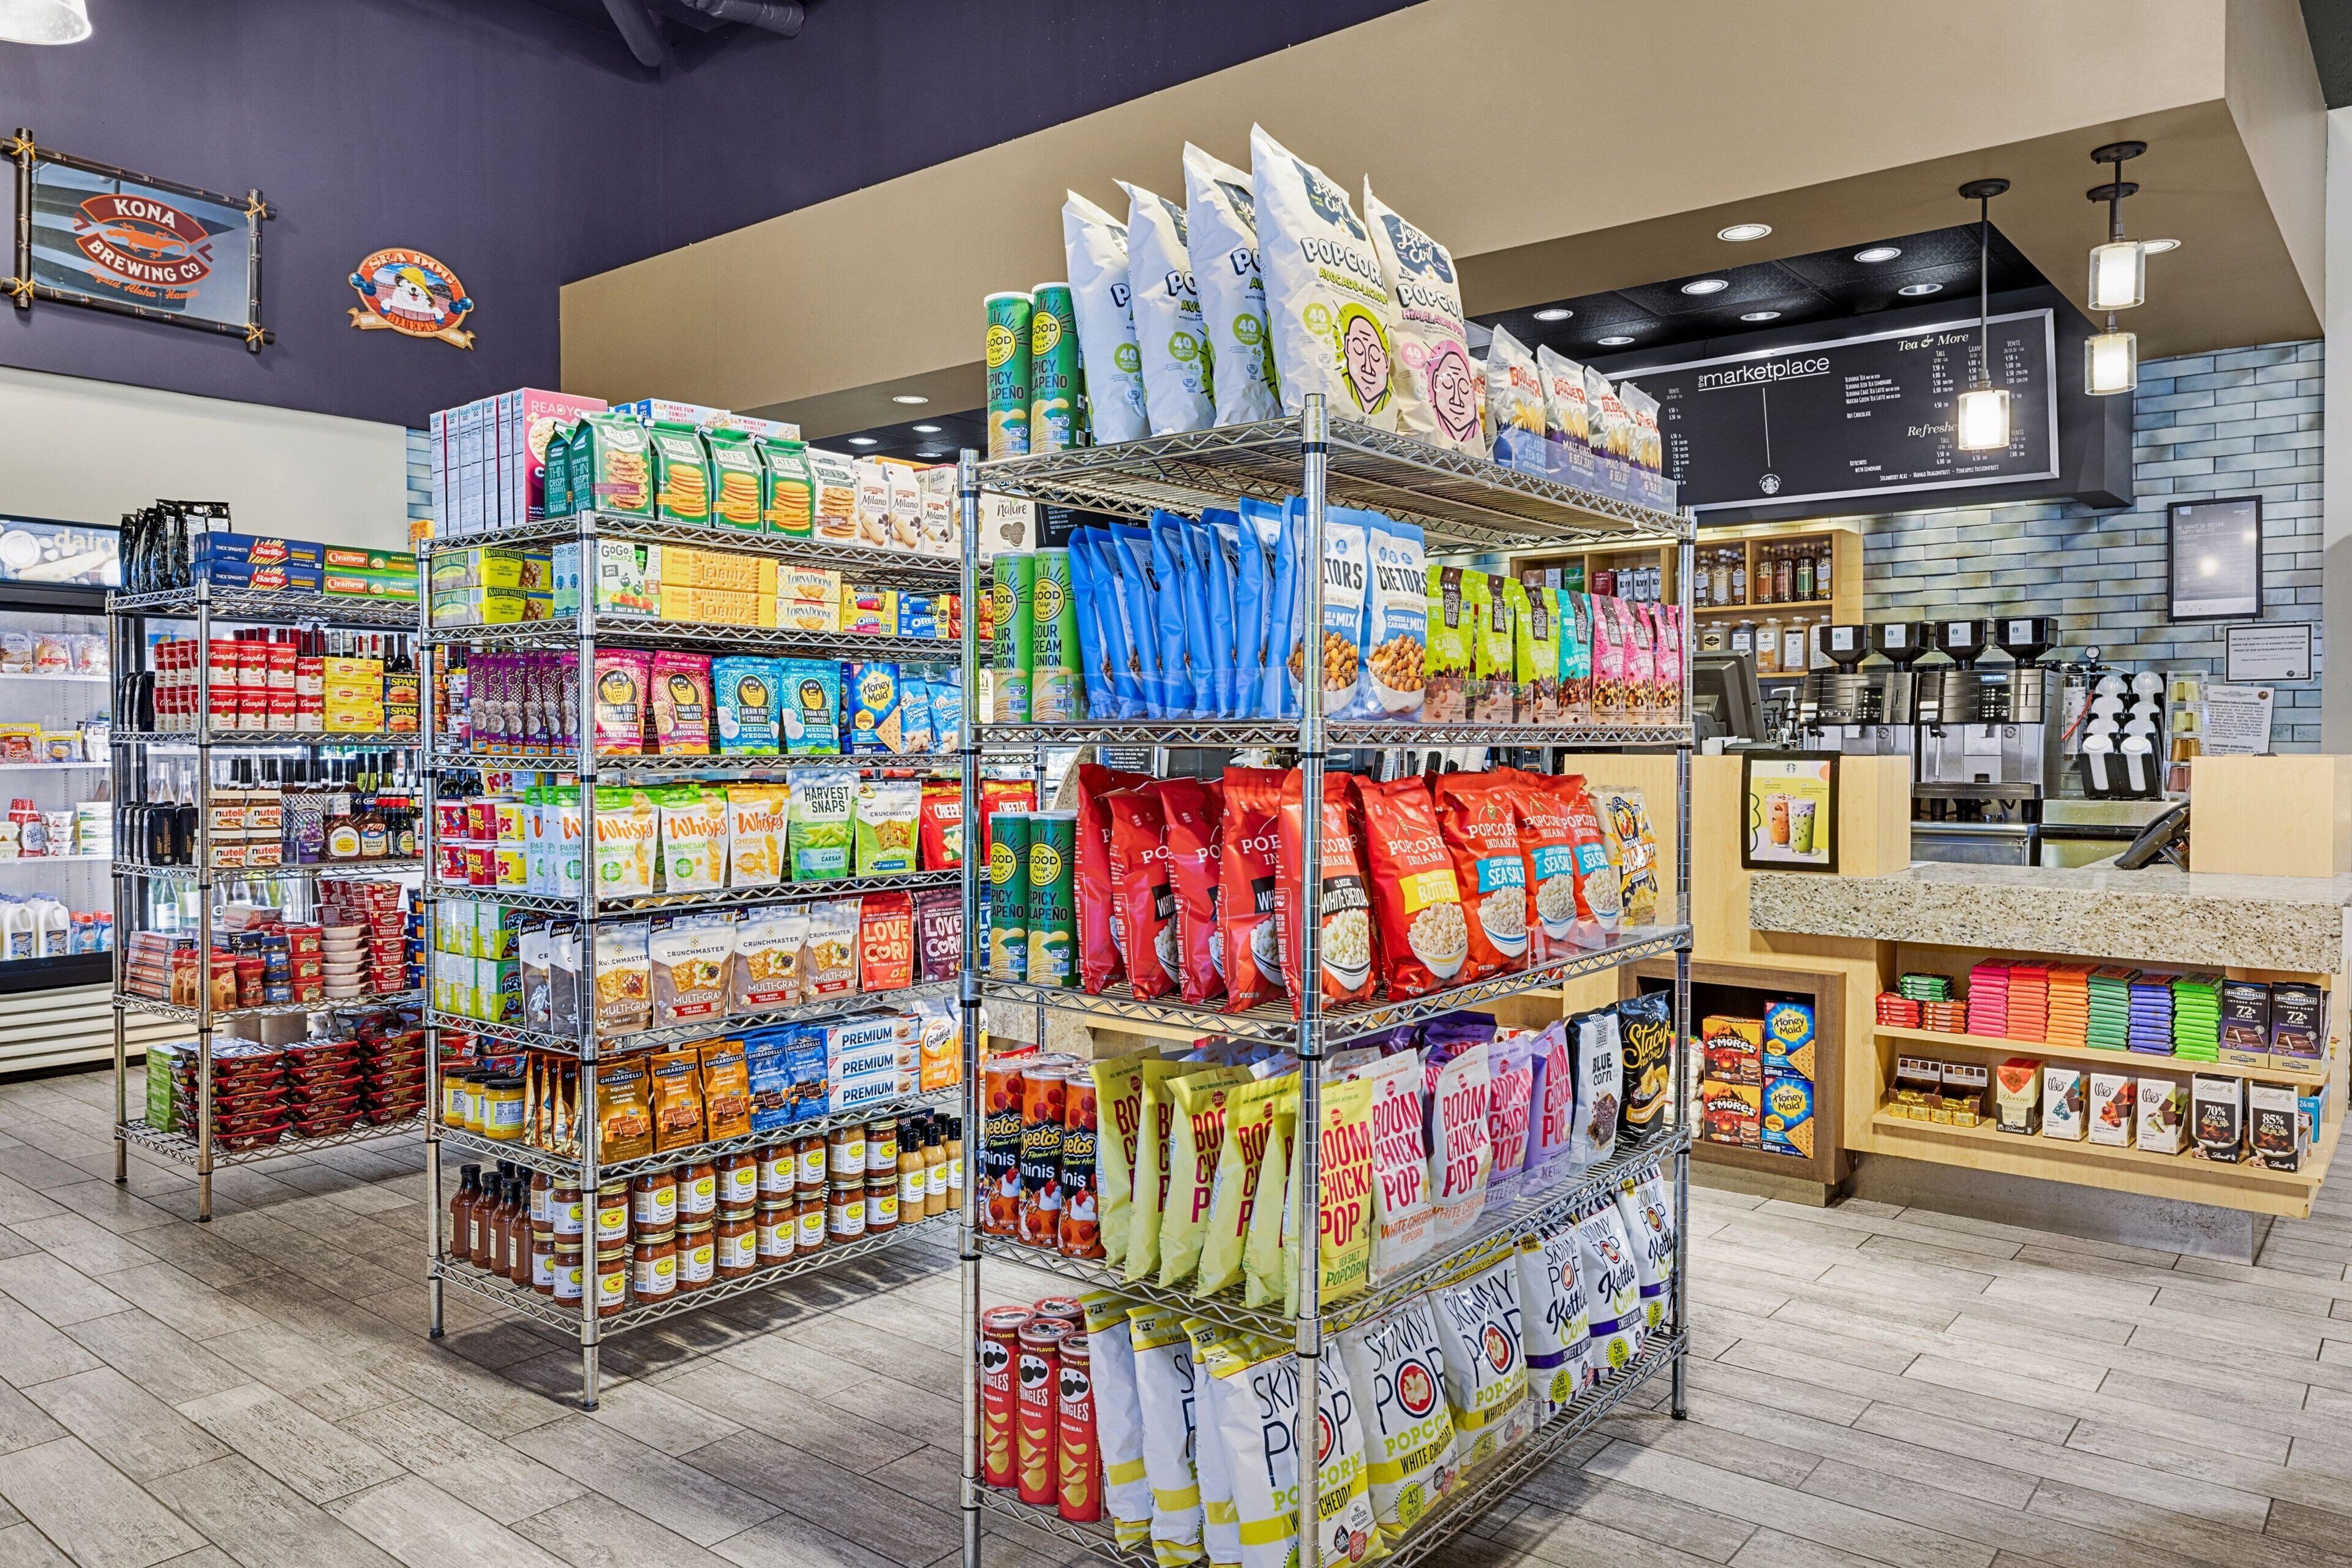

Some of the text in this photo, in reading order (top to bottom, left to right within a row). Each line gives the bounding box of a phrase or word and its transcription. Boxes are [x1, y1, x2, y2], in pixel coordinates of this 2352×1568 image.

[113, 199, 175, 228] KONA
[88, 239, 176, 281] BREWING
[369, 252, 455, 284] SEA DOG
[124, 284, 156, 297] Aloha
[1898, 333, 1969, 352] Tea & More
[1704, 357, 1830, 386] marketplace
[1554, 378, 1587, 405] BOULDER
[1907, 421, 1958, 437] Refreshe
[665, 439, 693, 451] TATE'S
[1562, 440, 1579, 454] MALT
[549, 466, 564, 478] THIN
[549, 478, 565, 487] CRISPY
[861, 494, 888, 507] Milano
[550, 504, 566, 513] BAKING
[997, 503, 1028, 517] nature
[55, 528, 119, 553] dairy
[256, 547, 283, 557] Barilla
[328, 551, 365, 564] Creamette
[485, 549, 524, 559] NATURE VALLEY
[787, 573, 833, 589] LORNA DOONE
[1378, 565, 1428, 595] CRETORS
[911, 617, 937, 627] OREO
[1388, 620, 1409, 629] CARAMEL
[1409, 616, 1425, 631] MIX
[1034, 625, 1058, 638] SOUR
[1039, 654, 1061, 667] ONION
[391, 678, 417, 687] SPAM
[862, 680, 891, 695] Honey
[867, 691, 888, 703] Maid
[804, 786, 850, 801] HARVEST
[812, 799, 846, 813] SNAPS
[664, 815, 726, 840] Whisps
[1488, 867, 1510, 886] SEA
[1334, 879, 1352, 889] CLASSIC
[1417, 878, 1455, 900] BUTTER
[743, 936, 799, 948] CRUNCHMASTER
[748, 979, 799, 991] MULTI-GRAIN
[2226, 990, 2264, 998] GHIRARDELLI
[842, 1025, 892, 1047] PREMIUM
[926, 1028, 951, 1047] Goldfish
[1622, 1020, 1672, 1068] Stacy's
[705, 1054, 742, 1066] GHIRARDELLI
[1593, 1052, 1613, 1074] BLUE
[2048, 1077, 2066, 1091] theo
[2199, 1082, 2225, 1092] Lindt
[1999, 1091, 2030, 1102] Divine
[1442, 1084, 1486, 1131] BOOM
[2205, 1105, 2226, 1116] 70%
[2262, 1114, 2284, 1125] 85%
[1446, 1124, 1487, 1163] CHICKA
[1442, 1155, 1479, 1199] POP
[1325, 1261, 1367, 1287] POPCORN
[1598, 1265, 1635, 1304] Kettle
[1613, 1291, 1637, 1316] Corn
[1364, 1305, 1441, 1372] SKINNY
[1060, 1423, 1082, 1432] ORIGINAL
[1401, 1425, 1452, 1474] WHITE CHEDDAR
